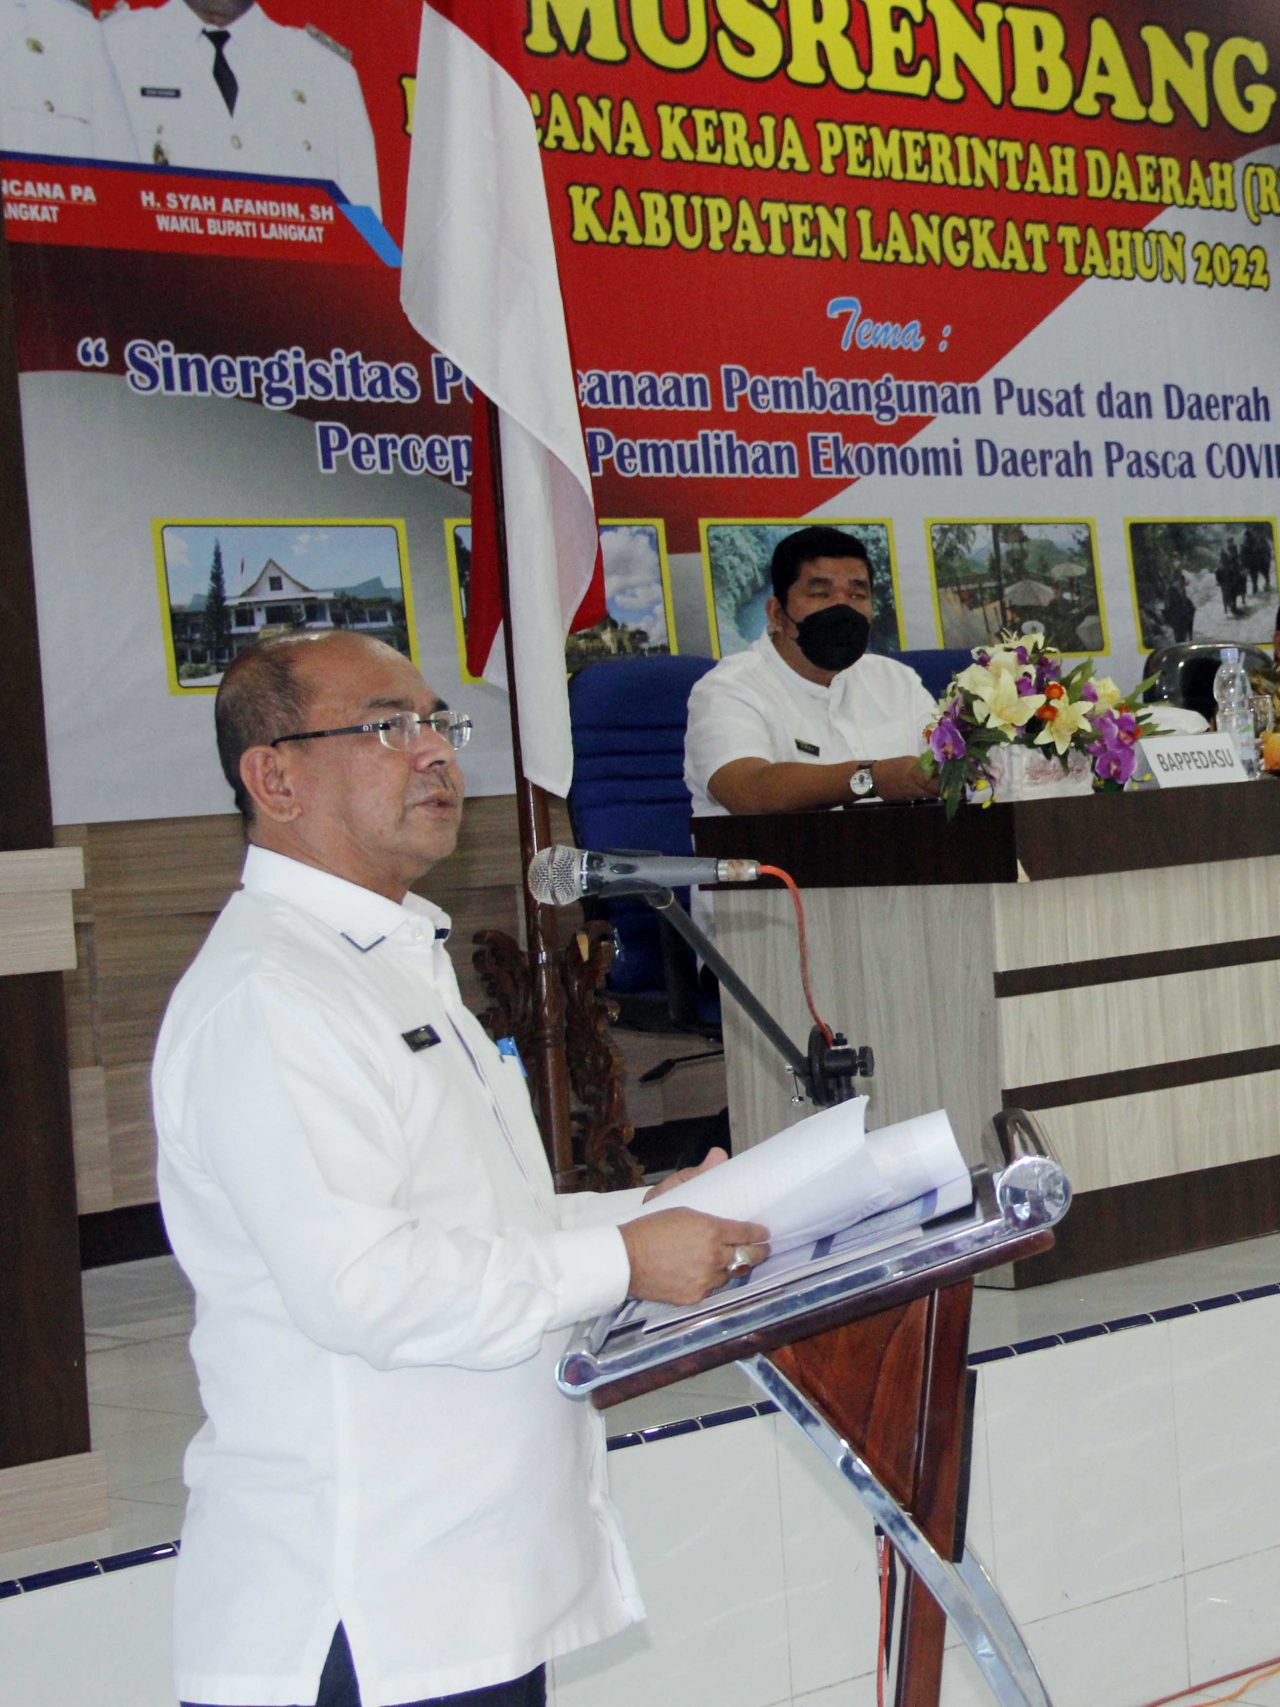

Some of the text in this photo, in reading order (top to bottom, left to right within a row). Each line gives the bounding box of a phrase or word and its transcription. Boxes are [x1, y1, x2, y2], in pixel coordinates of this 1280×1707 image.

[523, 0, 1277, 134] MUSRENBANG
[656, 104, 811, 173] KERJA
[814, 120, 1077, 197] PEMERINTAH
[1085, 149, 1235, 210] DAERAH
[70, 184, 97, 203] PA
[140, 191, 335, 222] H. SYAH AFANDIN, SH
[156, 214, 325, 243] WAKIL BUPATI LANGKAT
[567, 184, 1270, 290] KABUPATEN LANGKAT TAHUN 2022
[826, 296, 926, 351] Tema
[125, 338, 420, 409] Sinergisitas
[721, 365, 983, 425] Pembangunan
[992, 376, 1087, 419] Pusat
[1096, 381, 1154, 420] dan
[1162, 383, 1272, 424] Daerah
[585, 428, 800, 479] Pemulihan
[807, 432, 963, 478] Ekonomi
[974, 437, 1094, 479] Daerah
[1103, 440, 1197, 480] Pasca
[1156, 747, 1234, 773] BAPPEDASU
